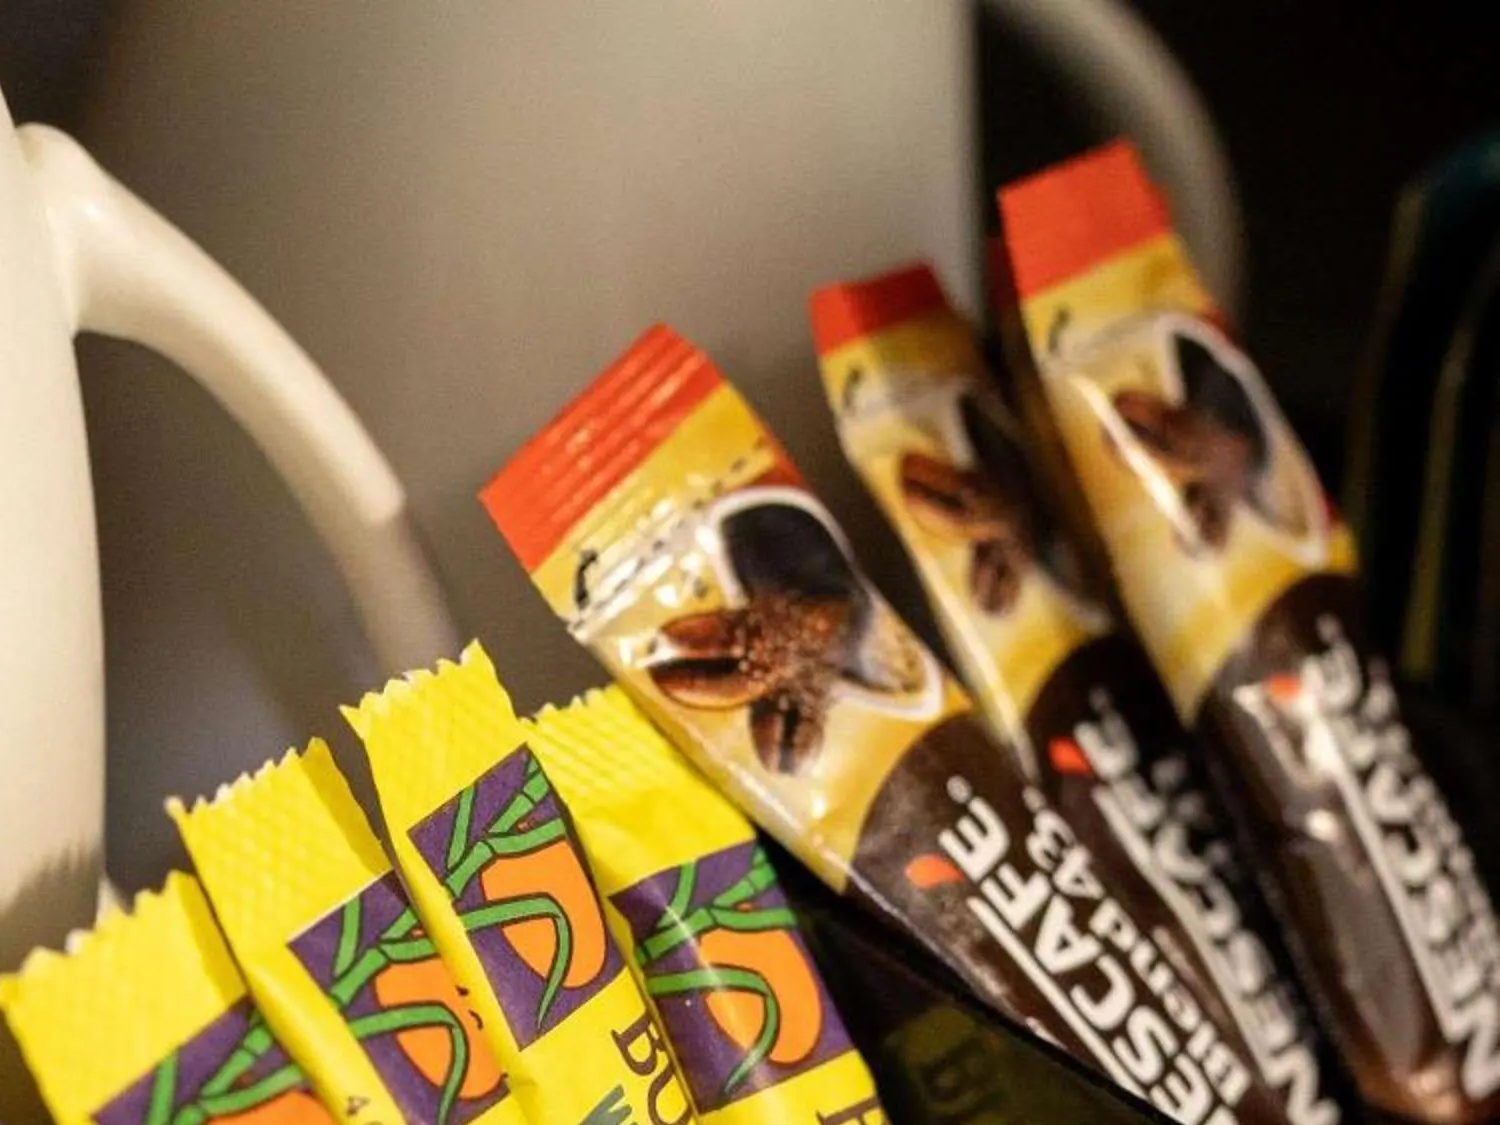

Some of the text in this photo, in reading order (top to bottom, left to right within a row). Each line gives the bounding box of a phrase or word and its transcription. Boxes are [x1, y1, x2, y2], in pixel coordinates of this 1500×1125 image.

[1024, 806, 1104, 902] 43
[1088, 897, 1253, 1107] Blend
[344, 1094, 371, 1118] 4
